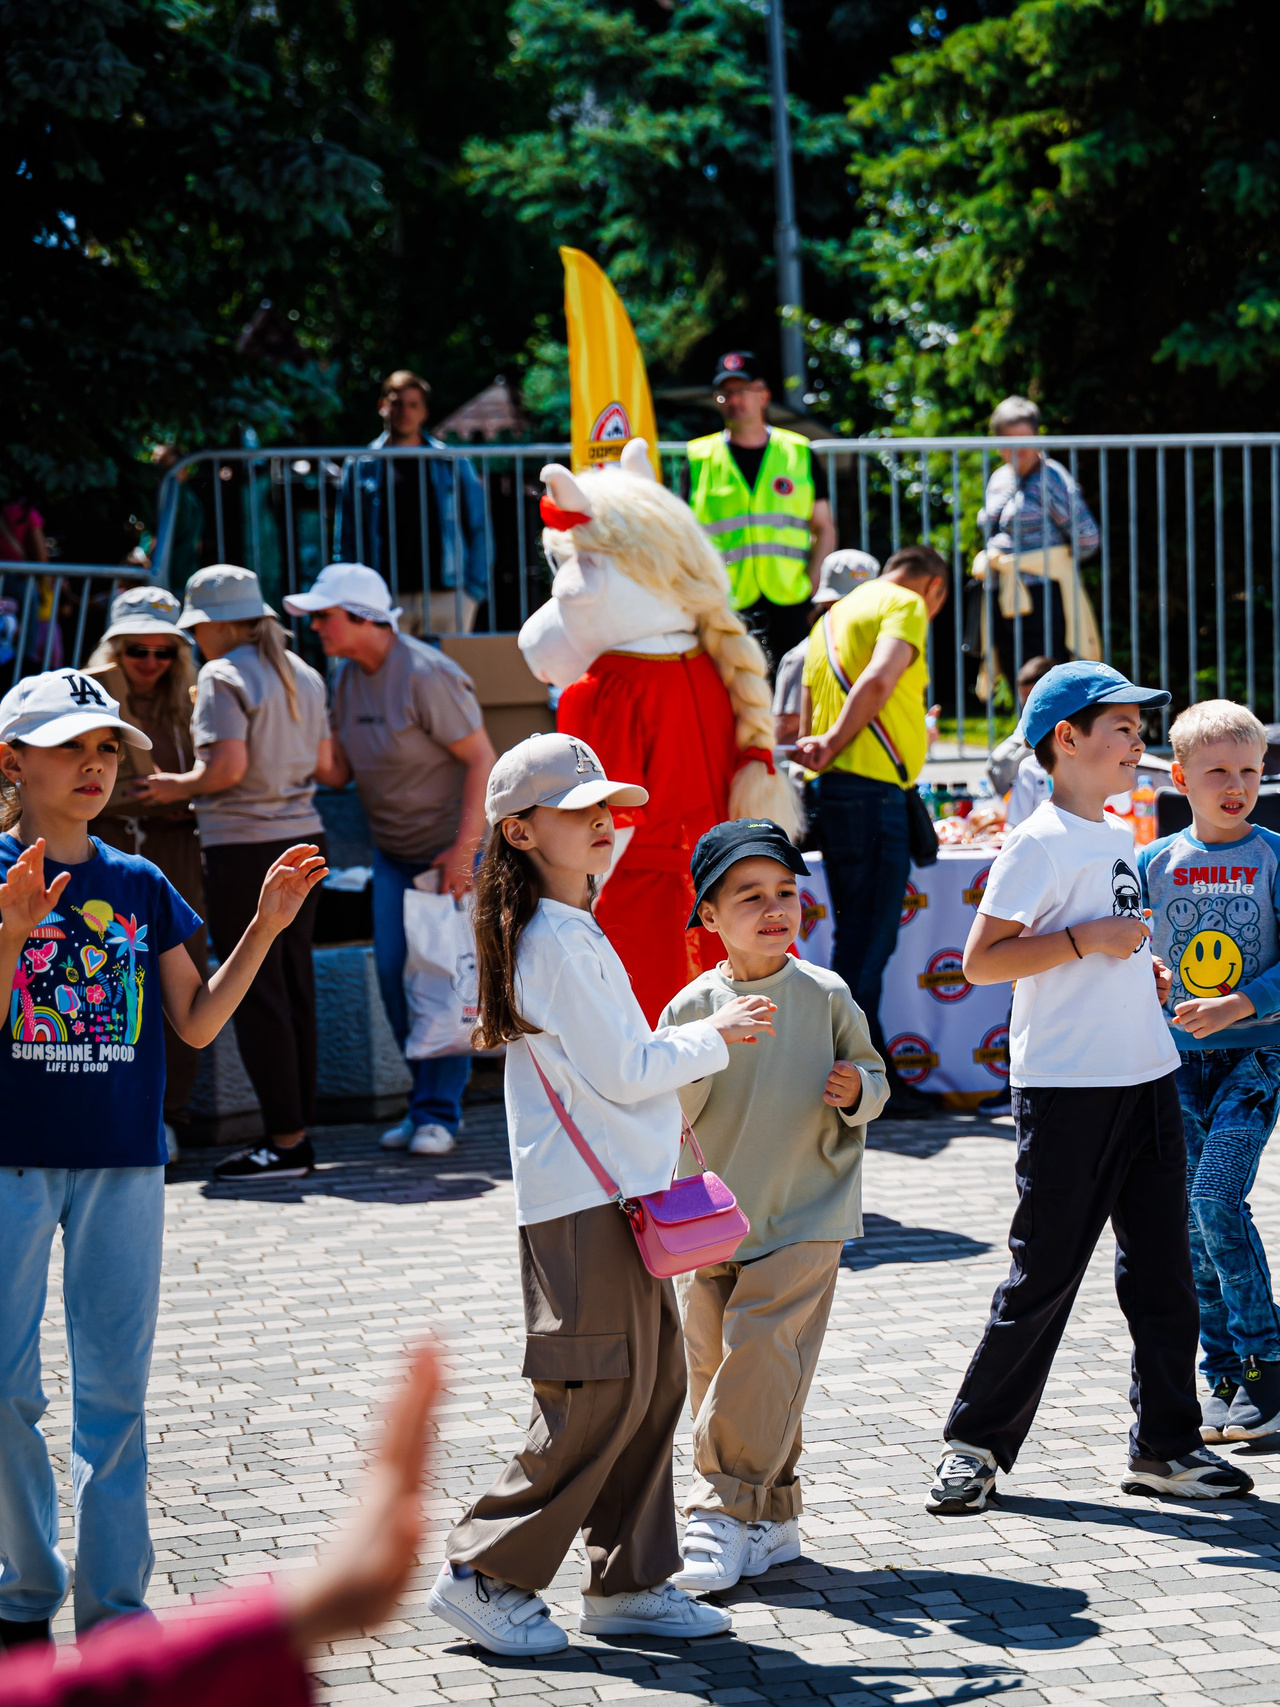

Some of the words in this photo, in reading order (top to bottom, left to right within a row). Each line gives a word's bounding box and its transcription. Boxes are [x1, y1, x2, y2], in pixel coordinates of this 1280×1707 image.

[62, 674, 106, 706] LA
[1173, 866, 1259, 886] SMILEY
[1192, 879, 1255, 895] Smile
[11, 1042, 93, 1061] SUNSHINE
[99, 1043, 135, 1062] MOOD
[46, 1062, 67, 1072] LIFE
[69, 1063, 79, 1073] IS
[82, 1063, 109, 1073] GOOD
